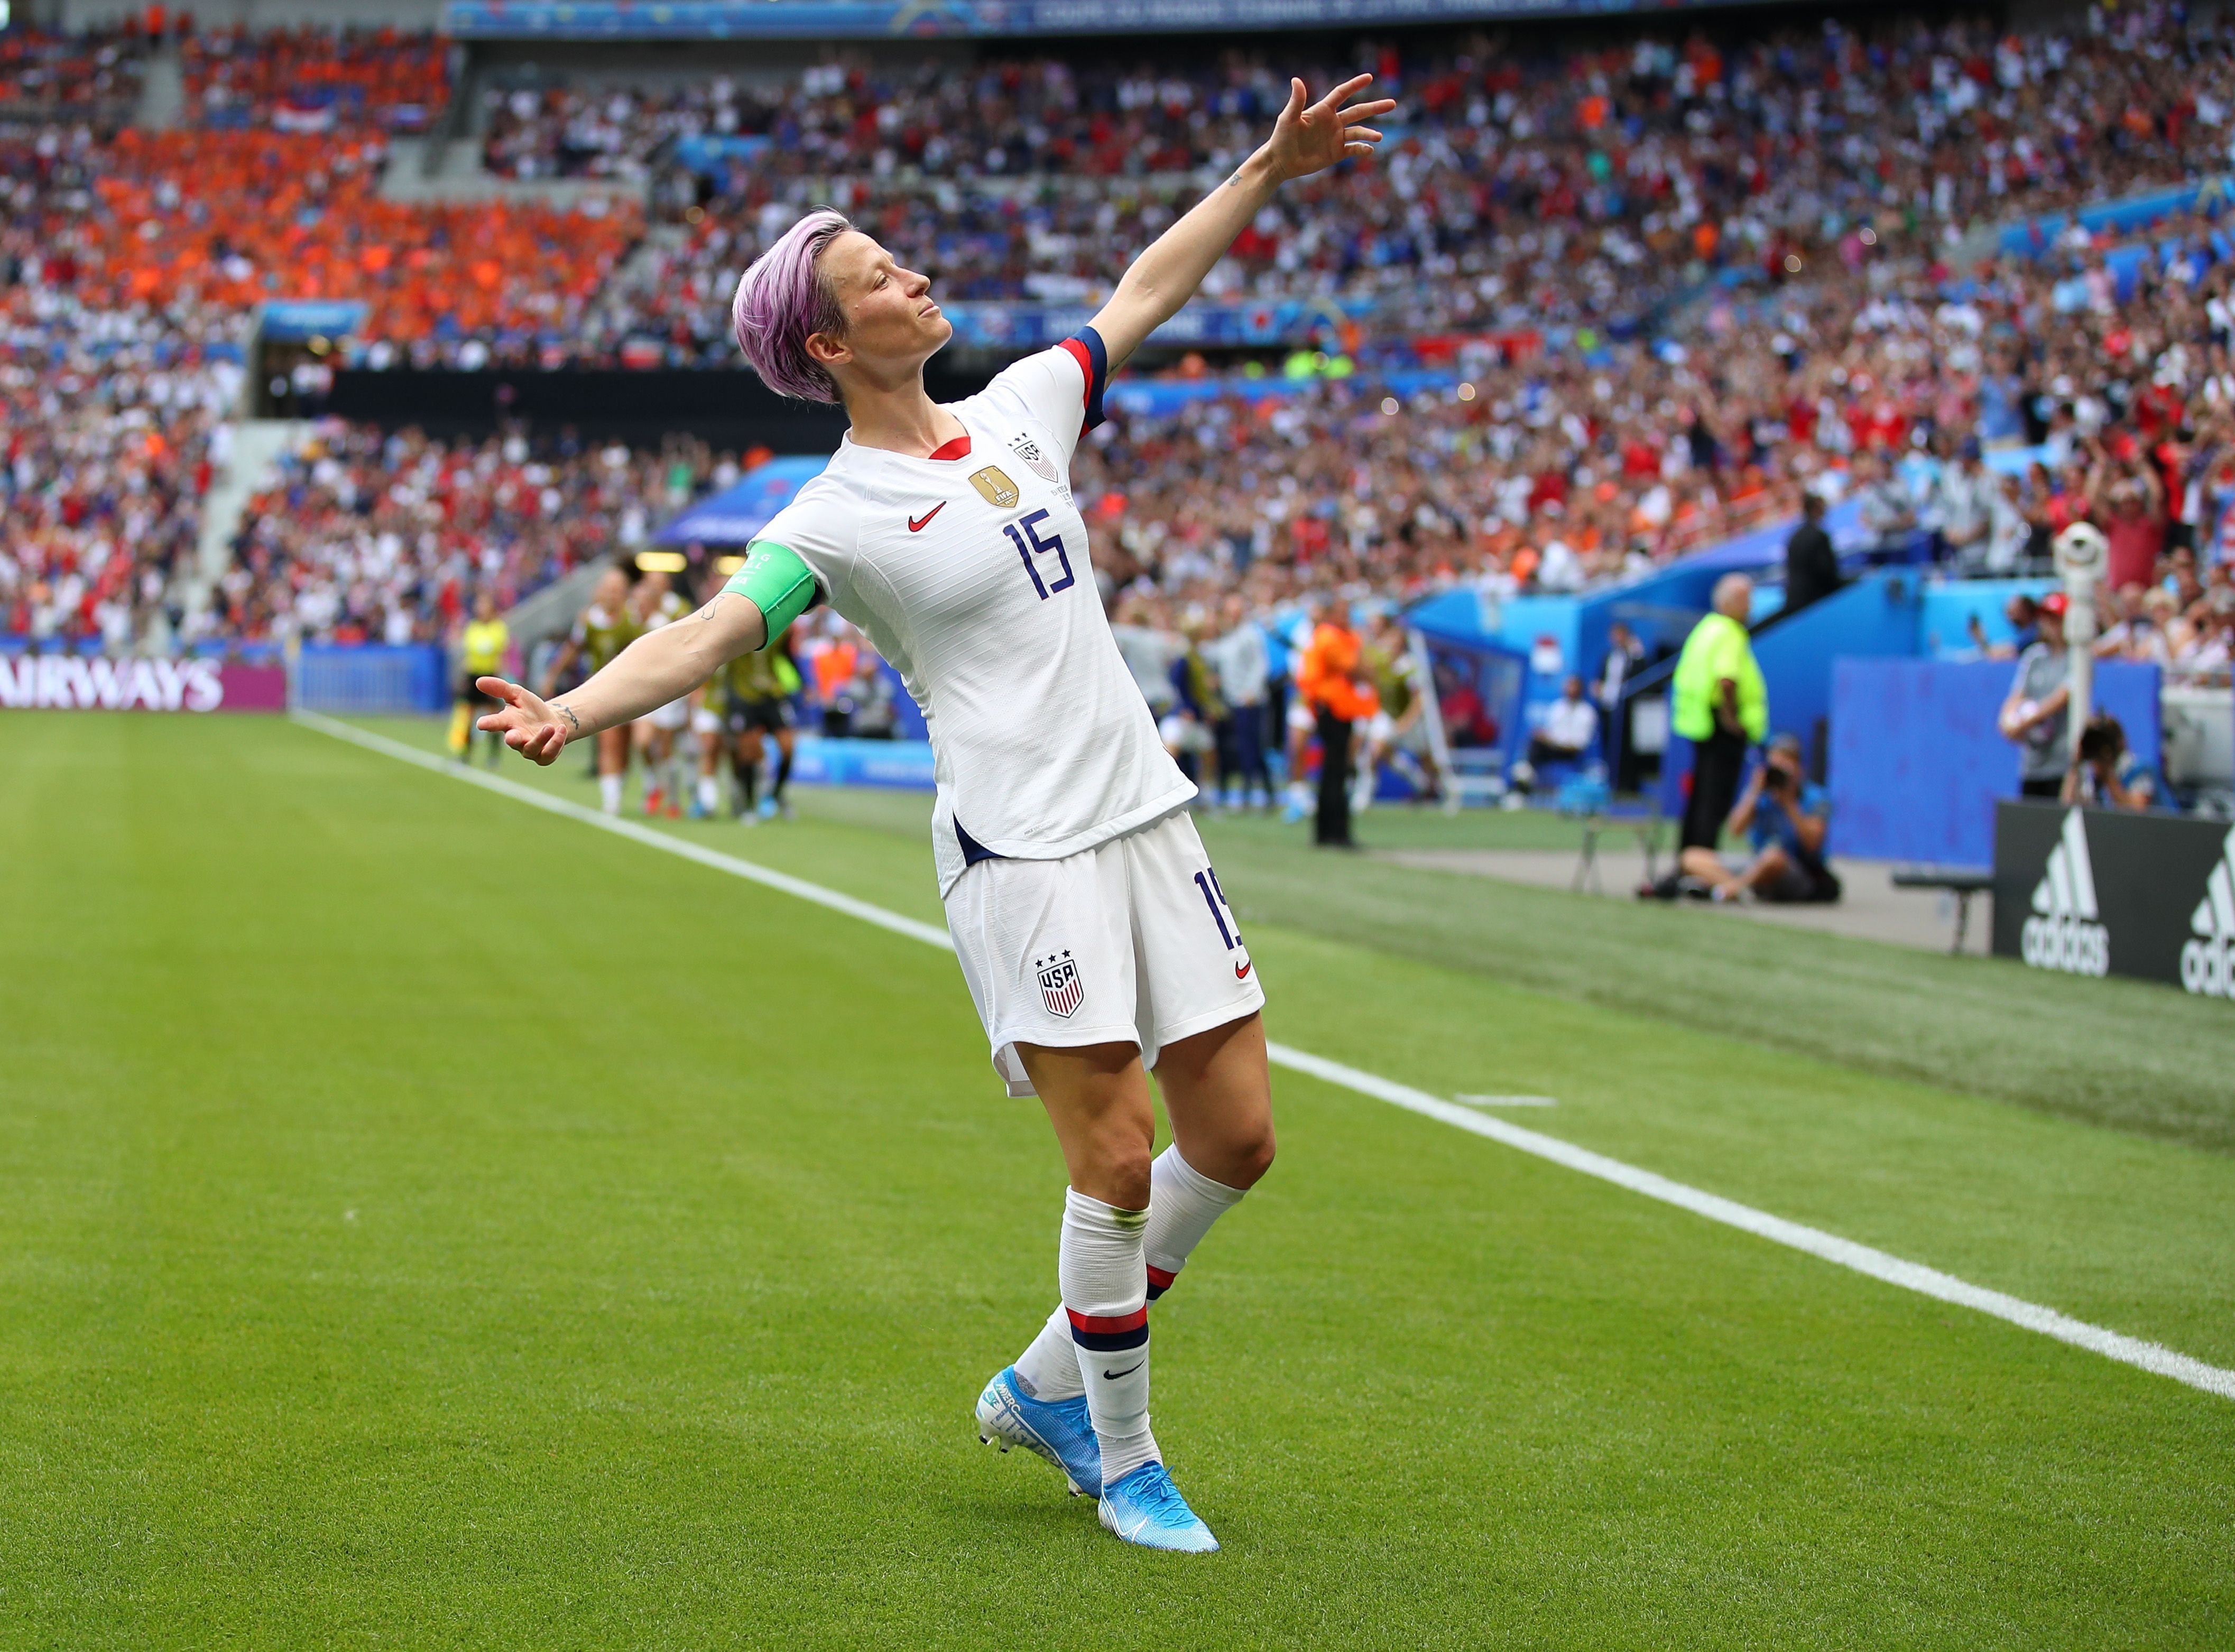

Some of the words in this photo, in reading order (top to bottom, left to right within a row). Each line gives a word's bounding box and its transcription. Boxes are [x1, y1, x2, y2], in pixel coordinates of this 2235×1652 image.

[1018, 444, 1040, 461] USA
[995, 490, 1012, 502] FIFA
[1003, 508, 1075, 600] 15
[2021, 911, 2109, 977] adidas
[1041, 964, 1074, 989] USA
[995, 1383, 1021, 1414] MERC
